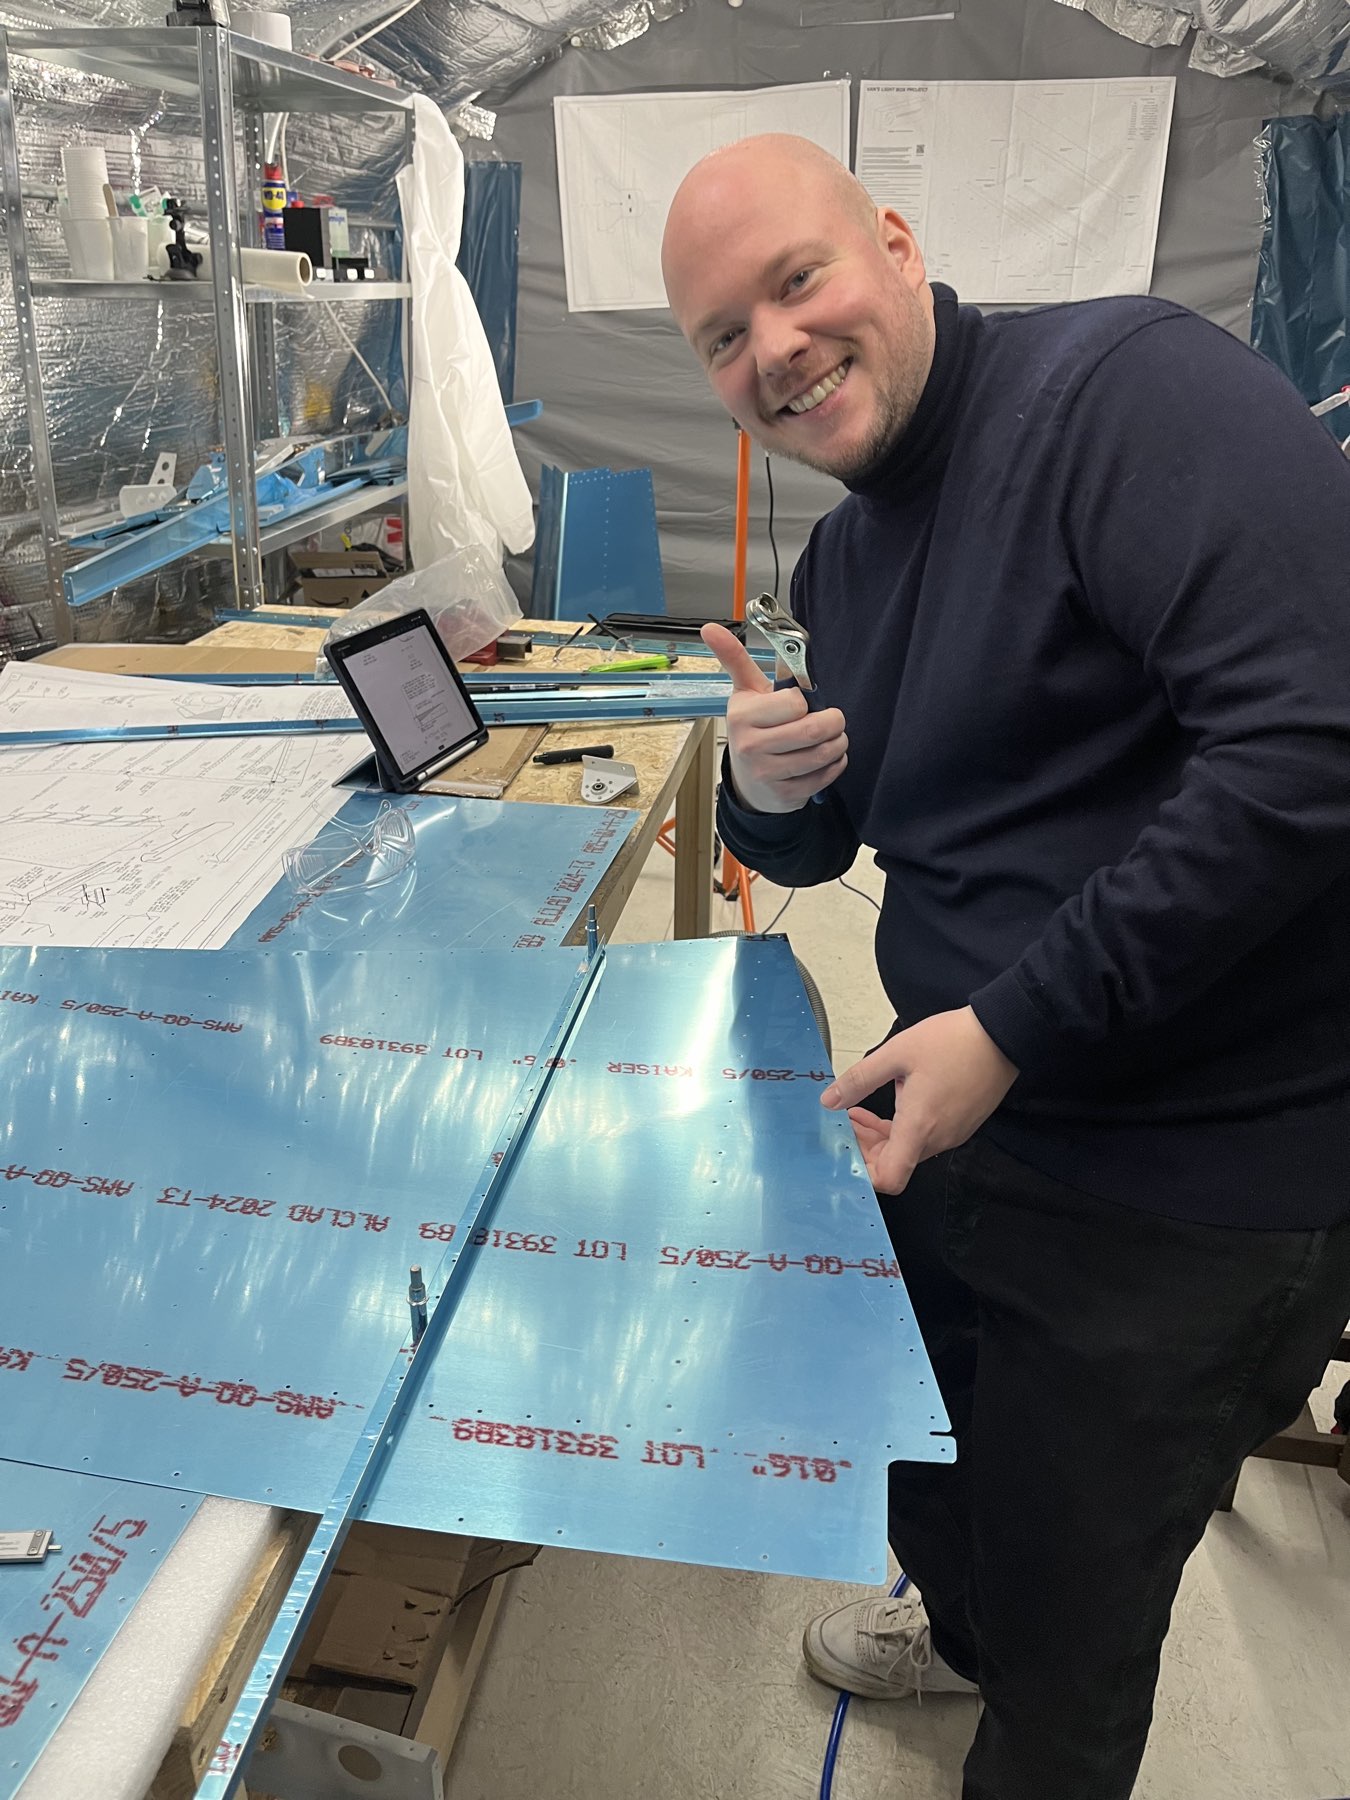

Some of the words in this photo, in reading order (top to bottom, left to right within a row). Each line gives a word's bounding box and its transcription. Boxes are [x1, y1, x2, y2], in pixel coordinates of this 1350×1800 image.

[59, 999, 244, 1033] AMS-QQ-A-250/5
[319, 1034, 428, 1056] 393183B9
[442, 1046, 484, 1061] LOT
[606, 1062, 693, 1076] KAISER
[156, 1187, 277, 1217] 2024-T3
[287, 1204, 391, 1232] ALCLAD
[573, 1239, 627, 1261] LOT
[452, 1418, 619, 1460] 393183B9
[640, 1440, 705, 1469] LOT
